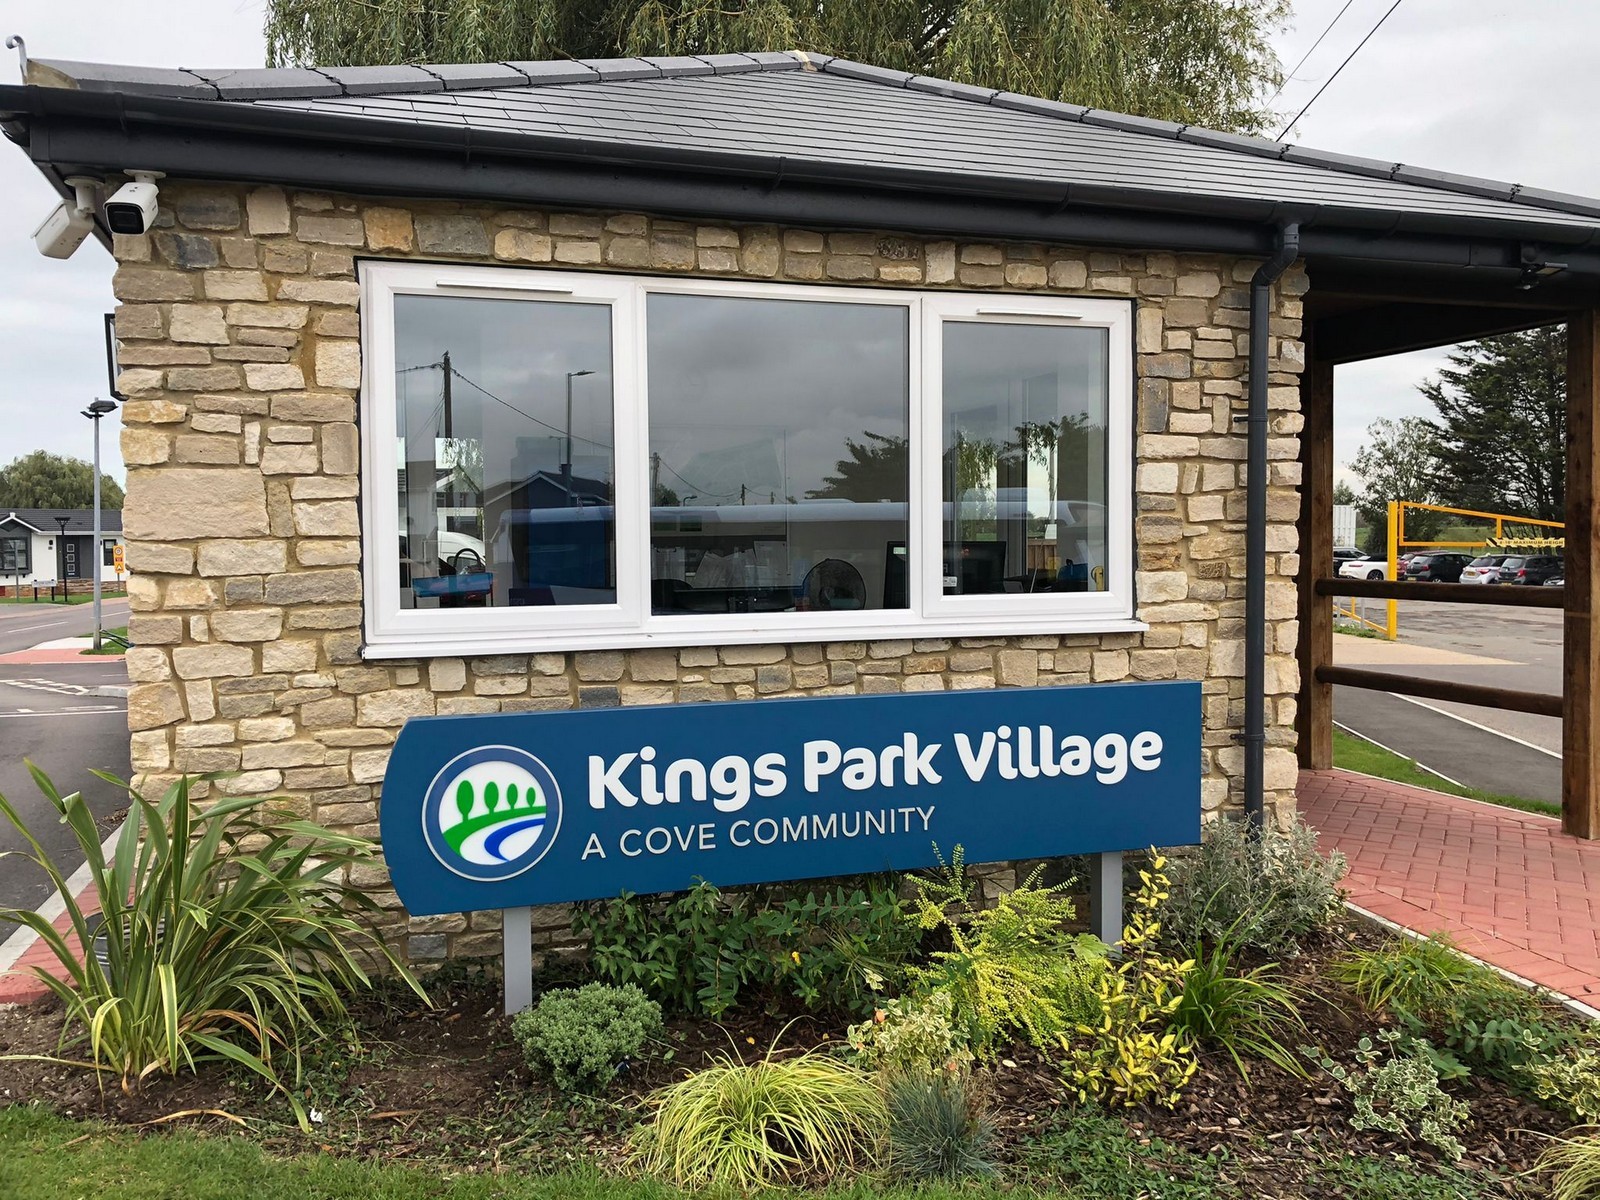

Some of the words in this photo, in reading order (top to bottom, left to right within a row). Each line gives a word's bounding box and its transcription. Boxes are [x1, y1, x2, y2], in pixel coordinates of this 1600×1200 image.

[588, 745, 787, 813] Kings
[803, 732, 943, 793] Park
[953, 725, 1163, 785] Village
[581, 832, 606, 861] A
[619, 823, 716, 857] COVE
[729, 805, 935, 847] COMMUNITY
